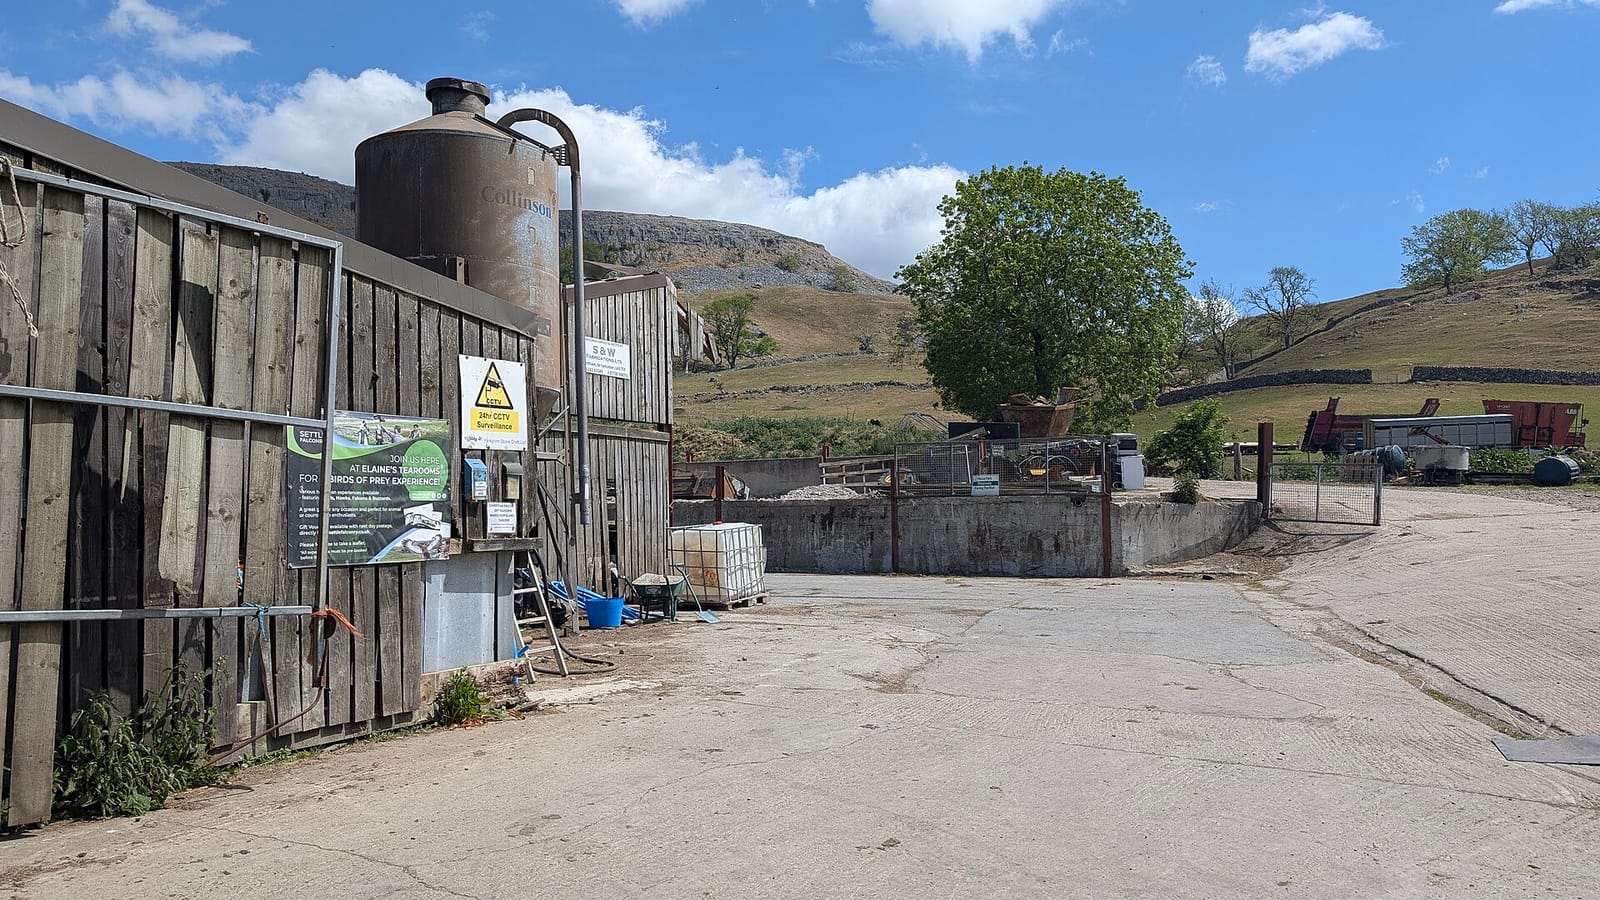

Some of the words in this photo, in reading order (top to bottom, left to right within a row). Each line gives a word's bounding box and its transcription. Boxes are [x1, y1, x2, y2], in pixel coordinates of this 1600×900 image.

[481, 185, 551, 218] Collinson
[477, 421, 512, 430] Surveillance
[390, 455, 407, 463] JOIN
[362, 465, 397, 473] ELAINE'S
[399, 467, 440, 475] TEAROOMS
[299, 474, 318, 482] FOR
[331, 475, 354, 484] BIRDS
[356, 476, 368, 484] OF
[370, 477, 392, 485] PREY
[392, 477, 440, 486] EXPERIENCE!
